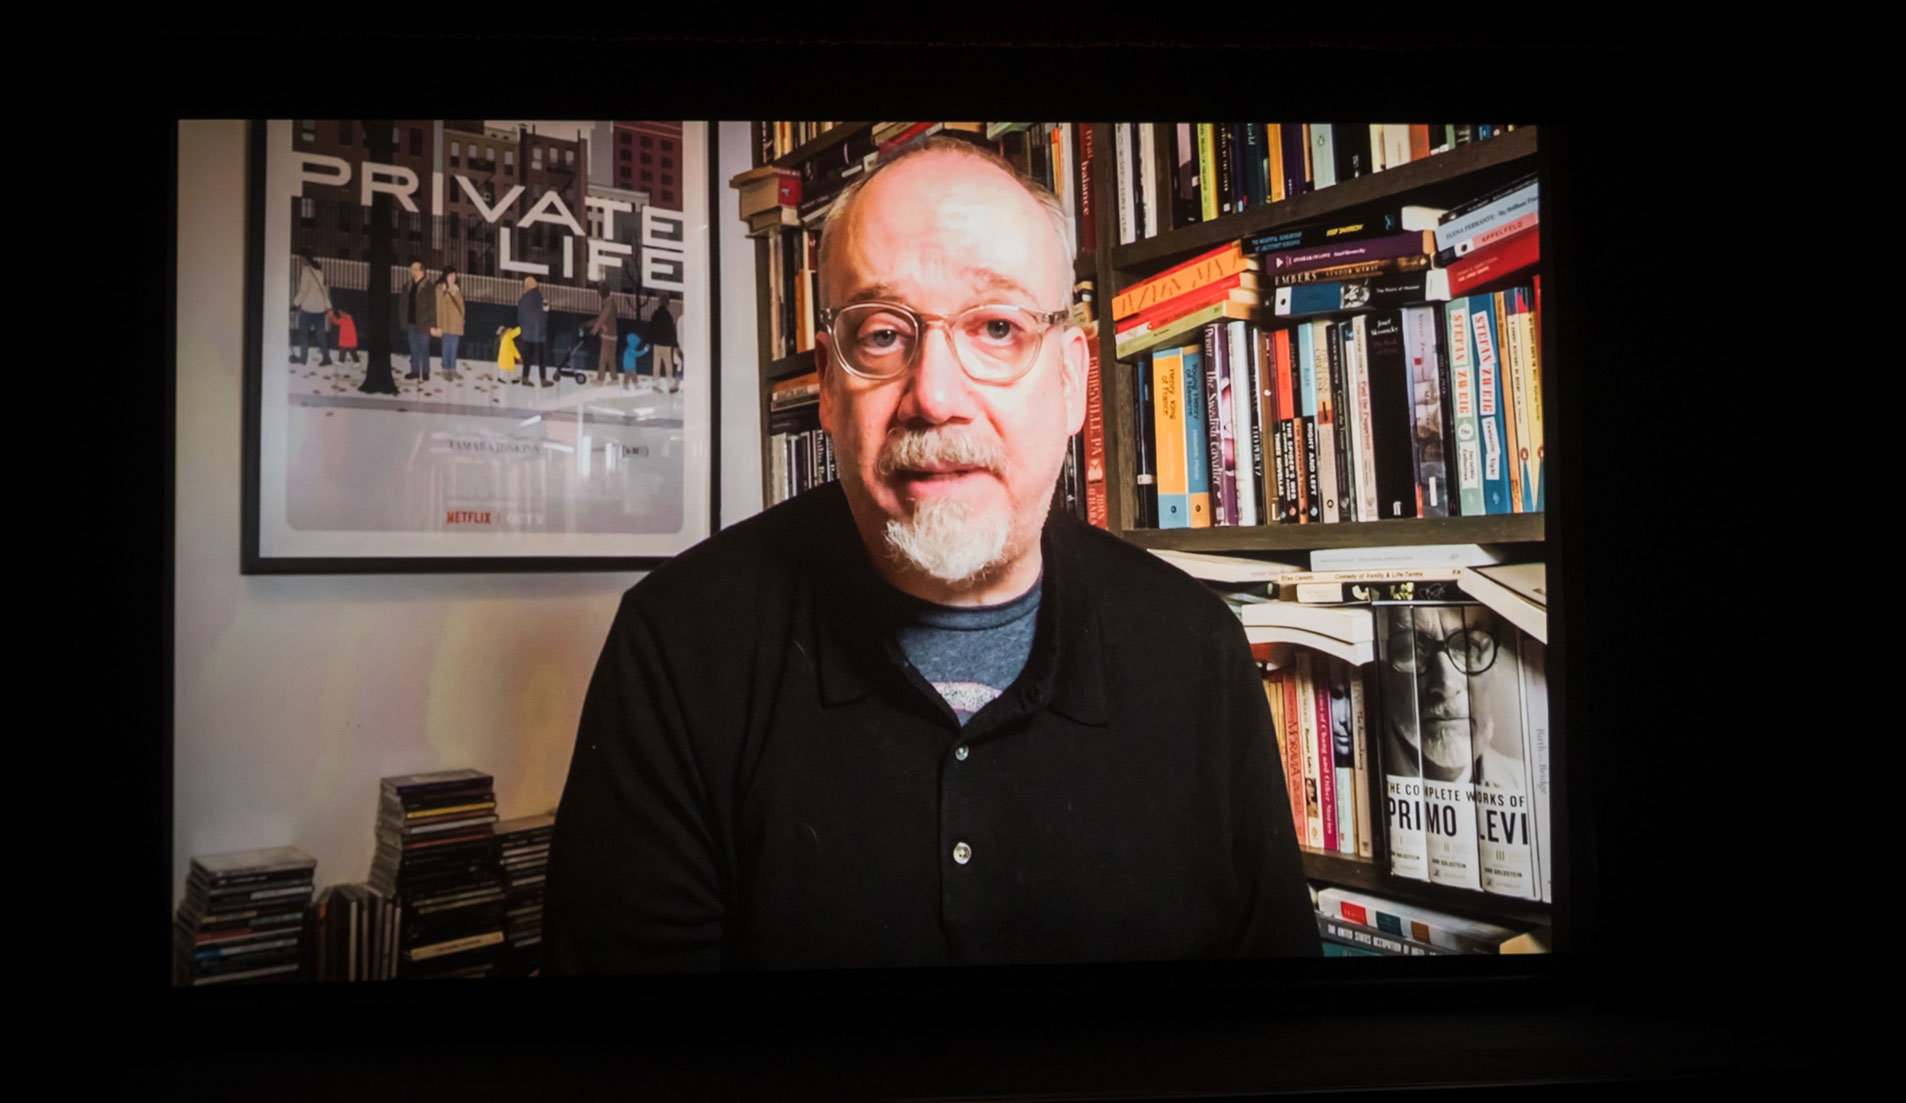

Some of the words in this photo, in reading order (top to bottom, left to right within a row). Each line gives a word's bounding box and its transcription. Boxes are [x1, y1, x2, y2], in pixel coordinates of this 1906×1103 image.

[1086, 129, 1094, 158] trial
[290, 150, 685, 251] PRIVATE
[1081, 160, 1090, 216] balance
[1481, 220, 1524, 243] APPELFELD
[499, 226, 685, 292] LIFE
[1275, 271, 1318, 287] EMBERS
[1453, 314, 1465, 361] STEFAN
[1475, 315, 1492, 363] STEFAN
[1161, 375, 1168, 384] of
[1206, 371, 1217, 388] The
[1457, 370, 1469, 414] ZWEIG
[1482, 367, 1493, 413] ZWEIG
[1208, 392, 1221, 438] Swedish
[1090, 438, 1101, 457] PA
[1287, 440, 1295, 479] SPIDER'S
[1308, 451, 1316, 472] AND
[1210, 441, 1224, 484] Cavalier
[1276, 456, 1284, 496] NOVELLAS
[446, 510, 492, 525] NETFLIX
[1335, 573, 1358, 581] Comedy
[1320, 713, 1328, 722] of
[1288, 720, 1300, 776] MORAVIA
[1320, 724, 1329, 754] Chang
[1536, 728, 1546, 752] Birth
[1322, 756, 1330, 774] and
[1324, 775, 1332, 802] Other
[1388, 781, 1400, 795] HE
[1466, 791, 1505, 807] WORKS
[1509, 795, 1526, 808] OF
[1326, 803, 1334, 835] Stories
[1388, 797, 1457, 837] PRIMO
[1480, 809, 1529, 846] EVI
[1441, 859, 1467, 869] GOLDSTEIN
[1494, 868, 1523, 878] GOLDSTEIN
[1327, 925, 1336, 935] THE
[1337, 927, 1353, 939] UNITED
[1354, 931, 1371, 944] STATES
[1373, 936, 1401, 952] OCCUPATION
[1403, 943, 1410, 954] OF
